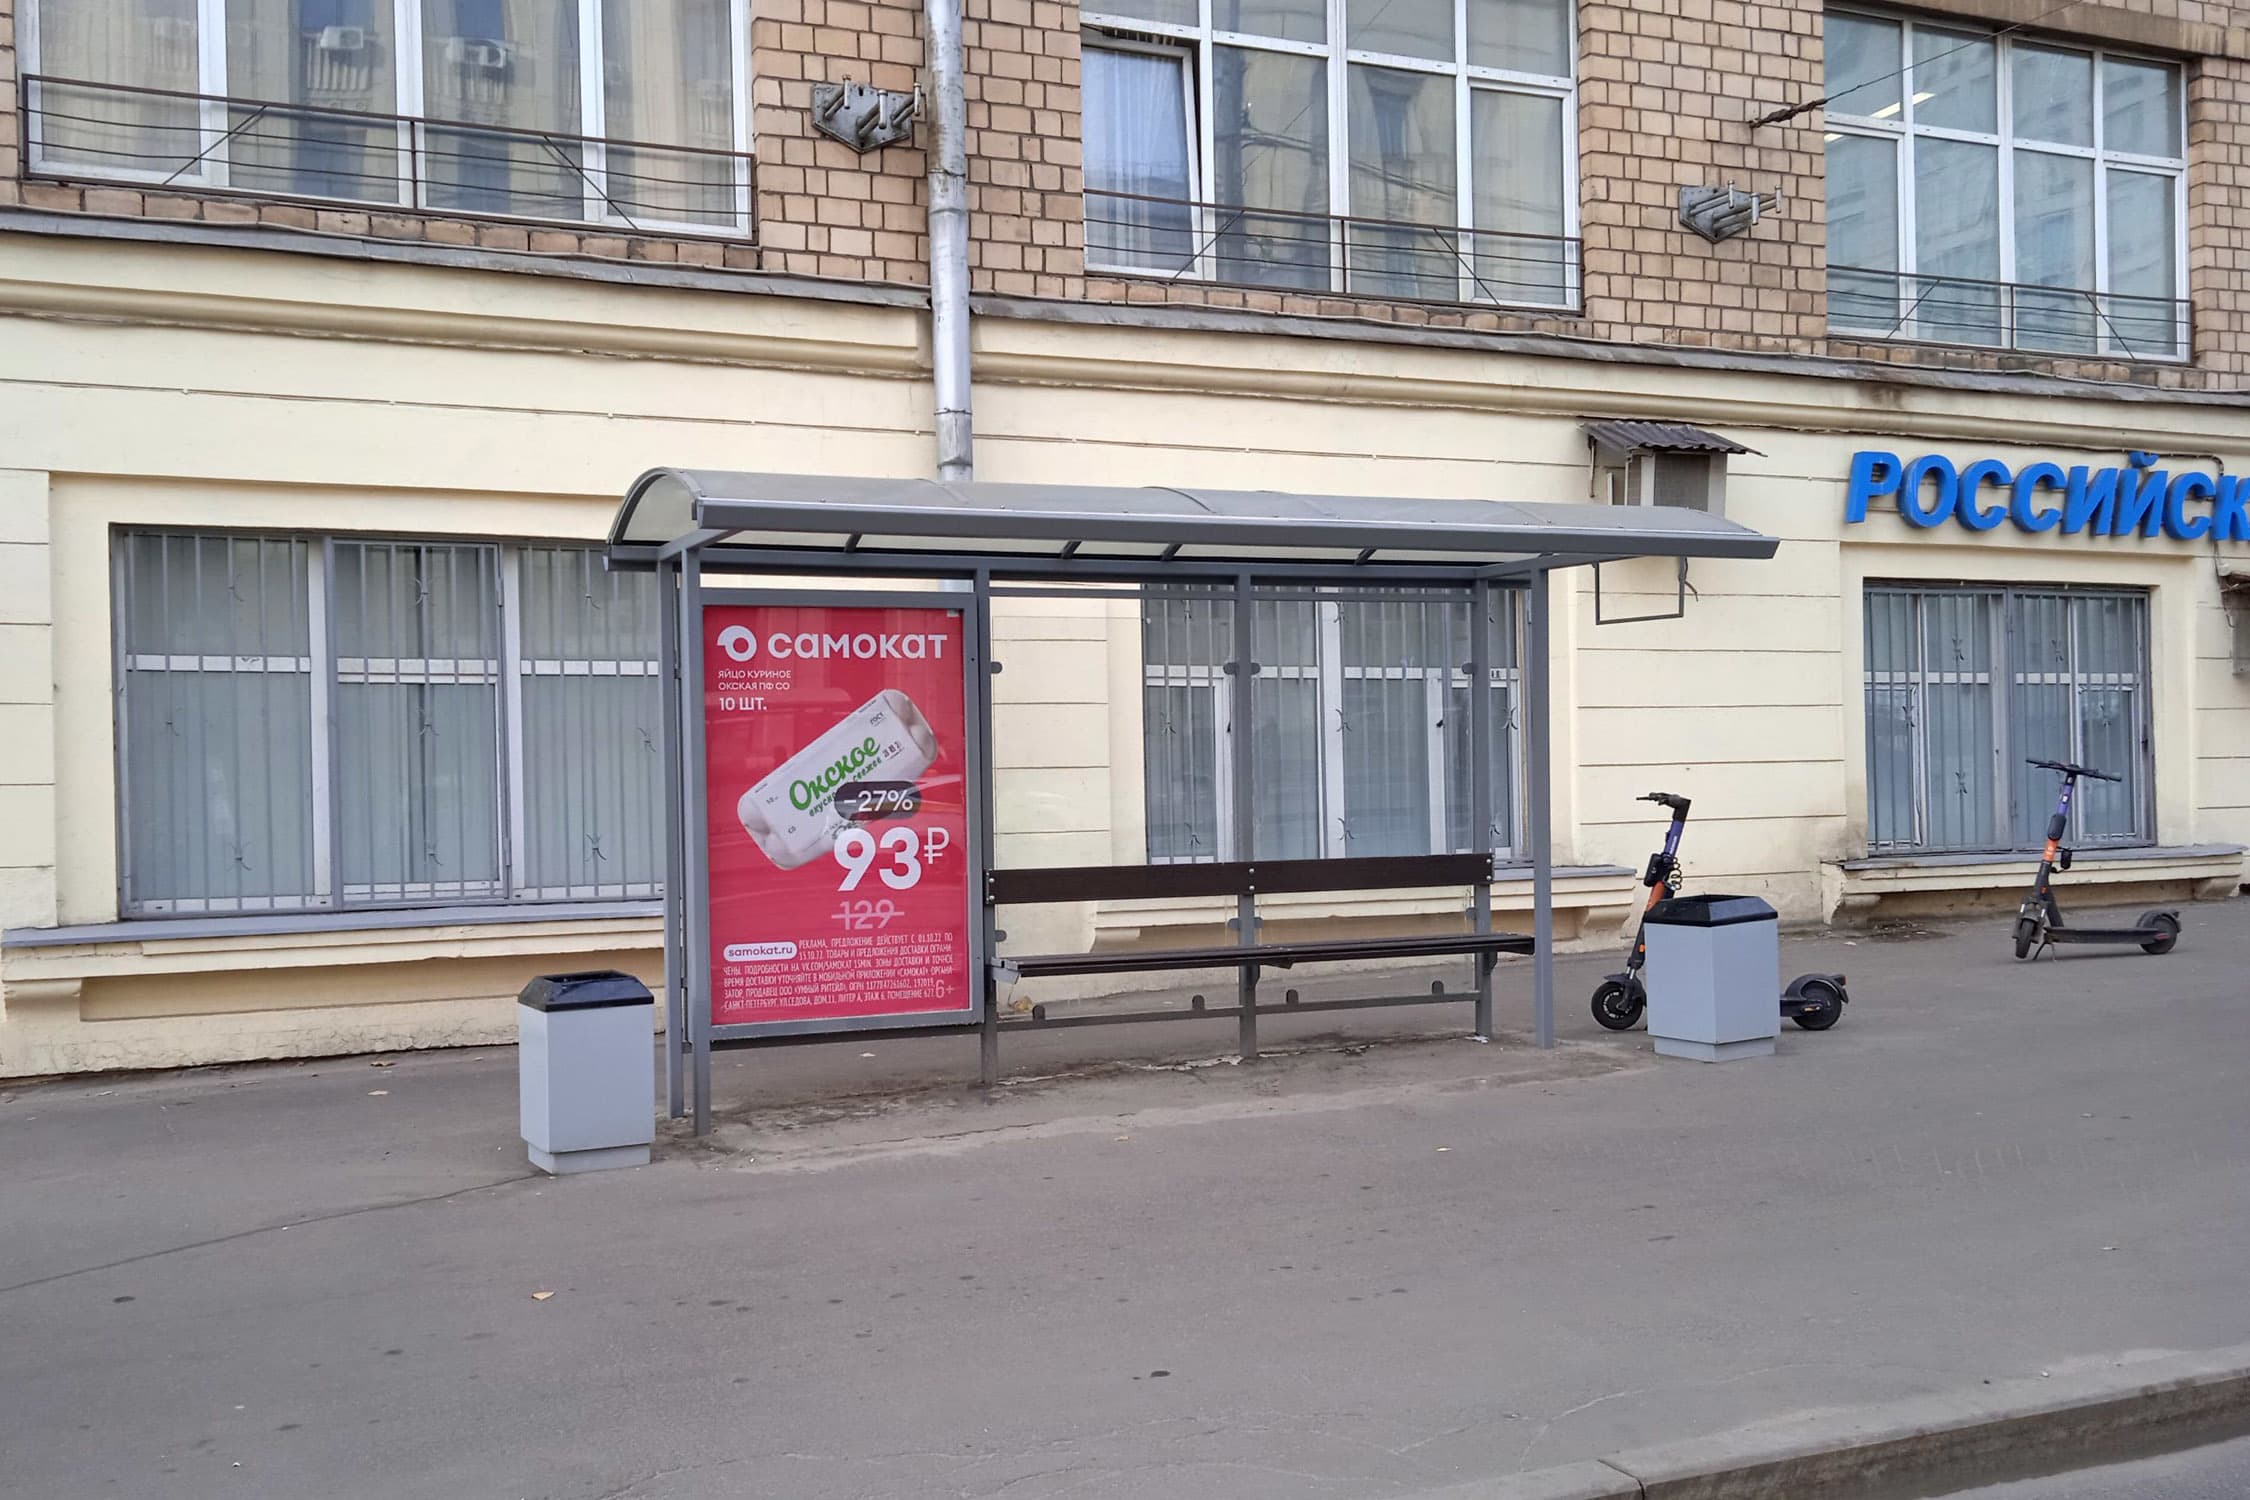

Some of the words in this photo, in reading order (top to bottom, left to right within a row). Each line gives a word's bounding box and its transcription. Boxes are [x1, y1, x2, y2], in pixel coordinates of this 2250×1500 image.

[1845, 451, 2250, 541] РОССИЙСК
[718, 668, 745, 679] ЯЙЦО
[747, 670, 791, 679] КУРИНОЕ
[718, 682, 757, 690] ОКСКАЯ
[759, 682, 774, 690] ПФ
[719, 697, 735, 711] 10
[739, 697, 767, 711] ШТ.
[789, 737, 880, 810] Окское
[844, 790, 913, 812] -27%
[840, 899, 895, 930] 129
[876, 934, 908, 945] ДЕЙСТВУЕТ
[944, 932, 952, 941] ПО
[728, 945, 793, 957] samokat.ru
[790, 963, 799, 972] НА
[779, 986, 792, 995] ООО
[935, 979, 955, 999] 6+
